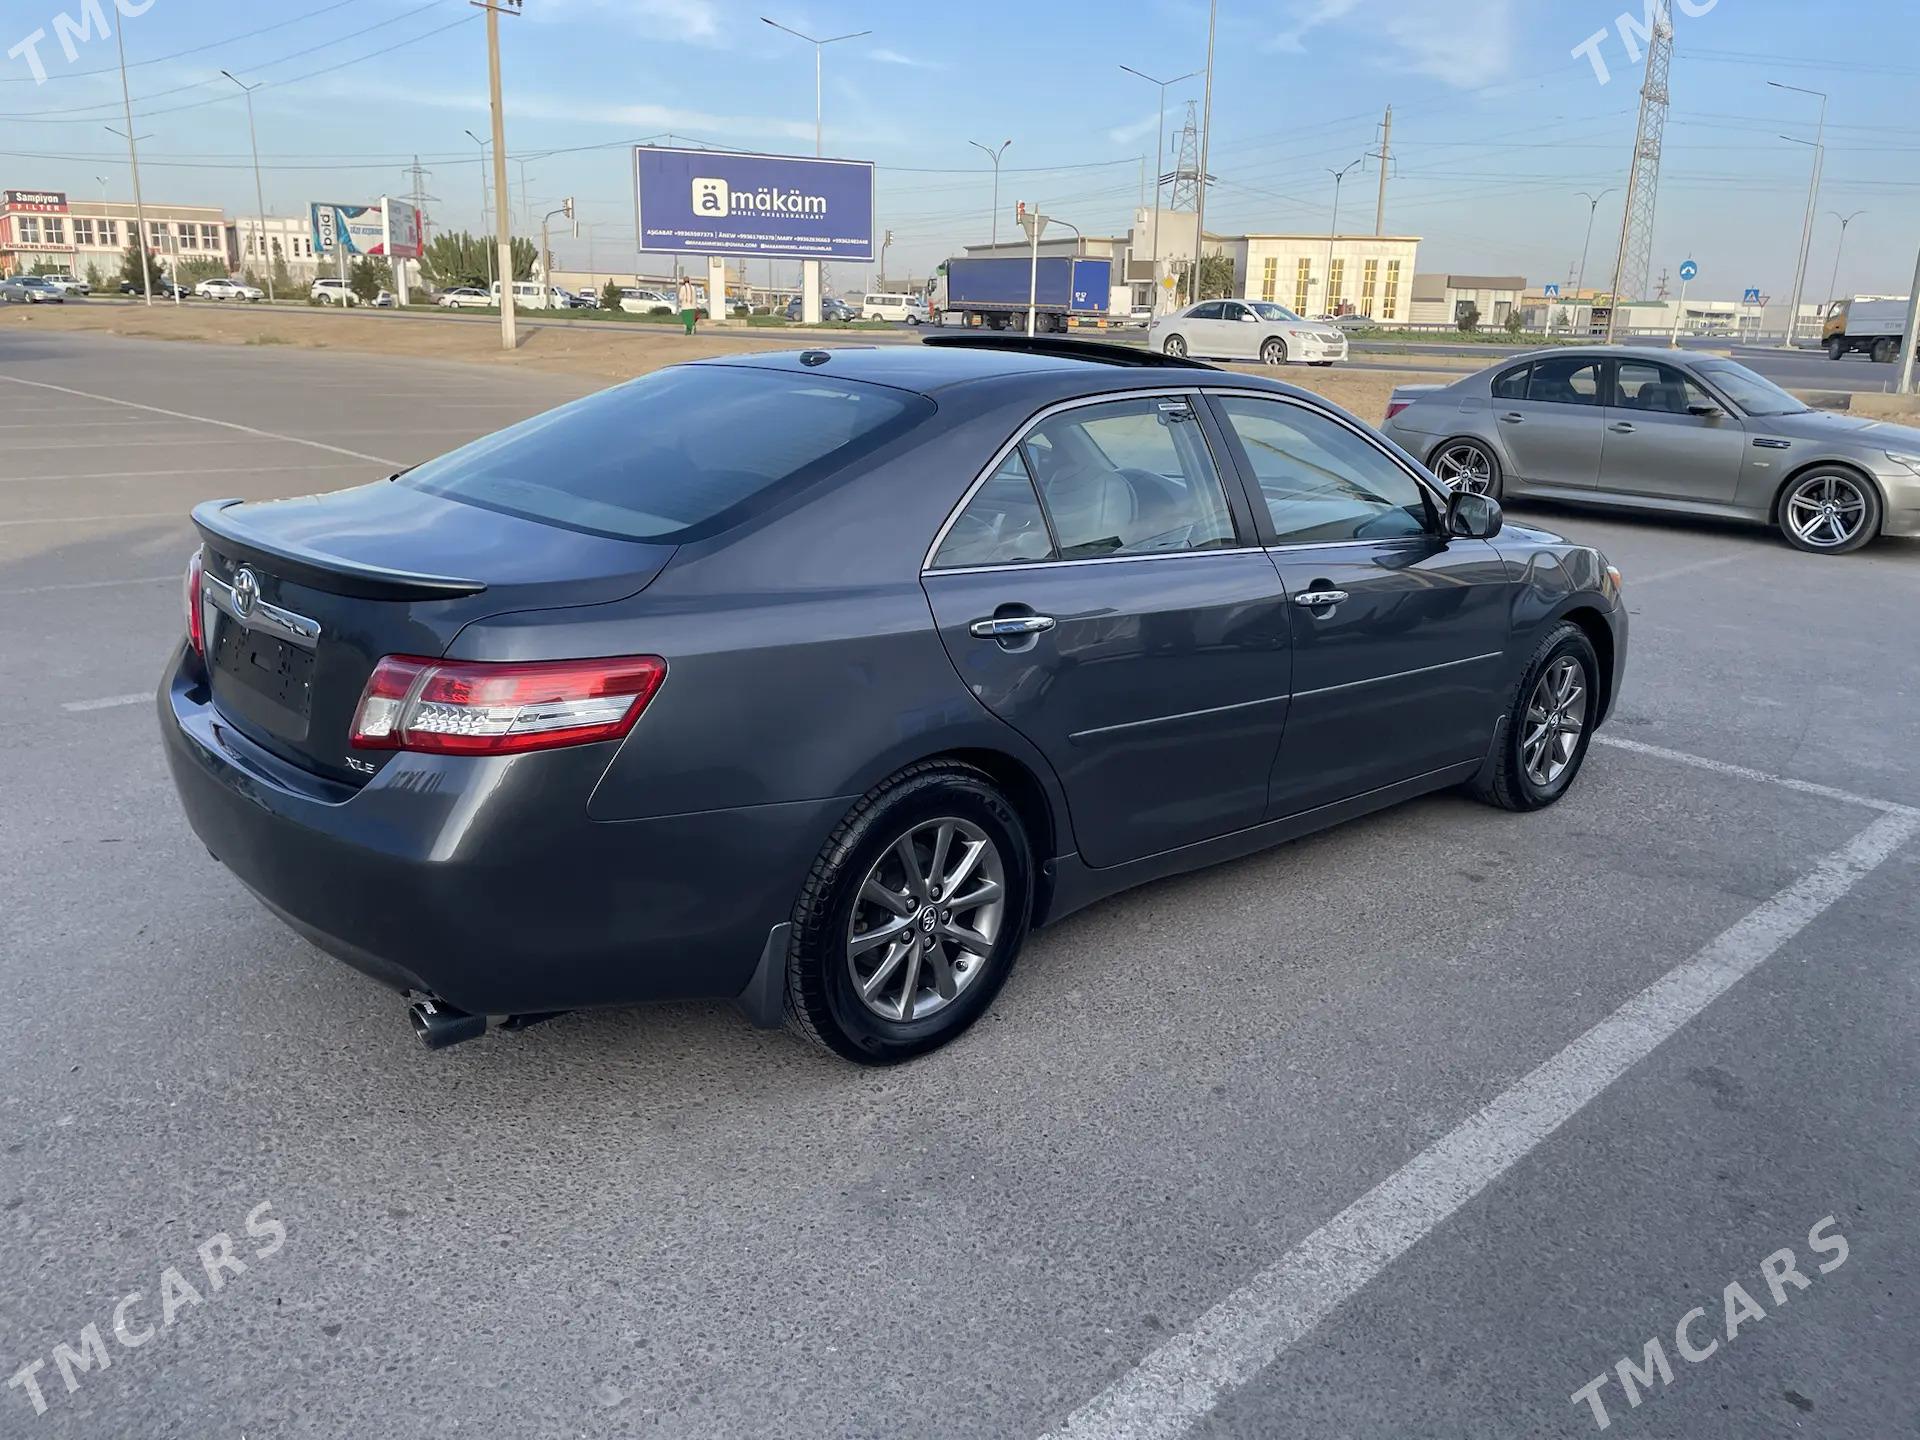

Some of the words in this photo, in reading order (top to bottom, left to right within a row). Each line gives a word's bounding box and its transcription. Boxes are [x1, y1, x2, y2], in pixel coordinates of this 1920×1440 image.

[15, 203, 60, 211] FILTER
[730, 187, 827, 213] mäkäm
[344, 756, 376, 775] XLE
